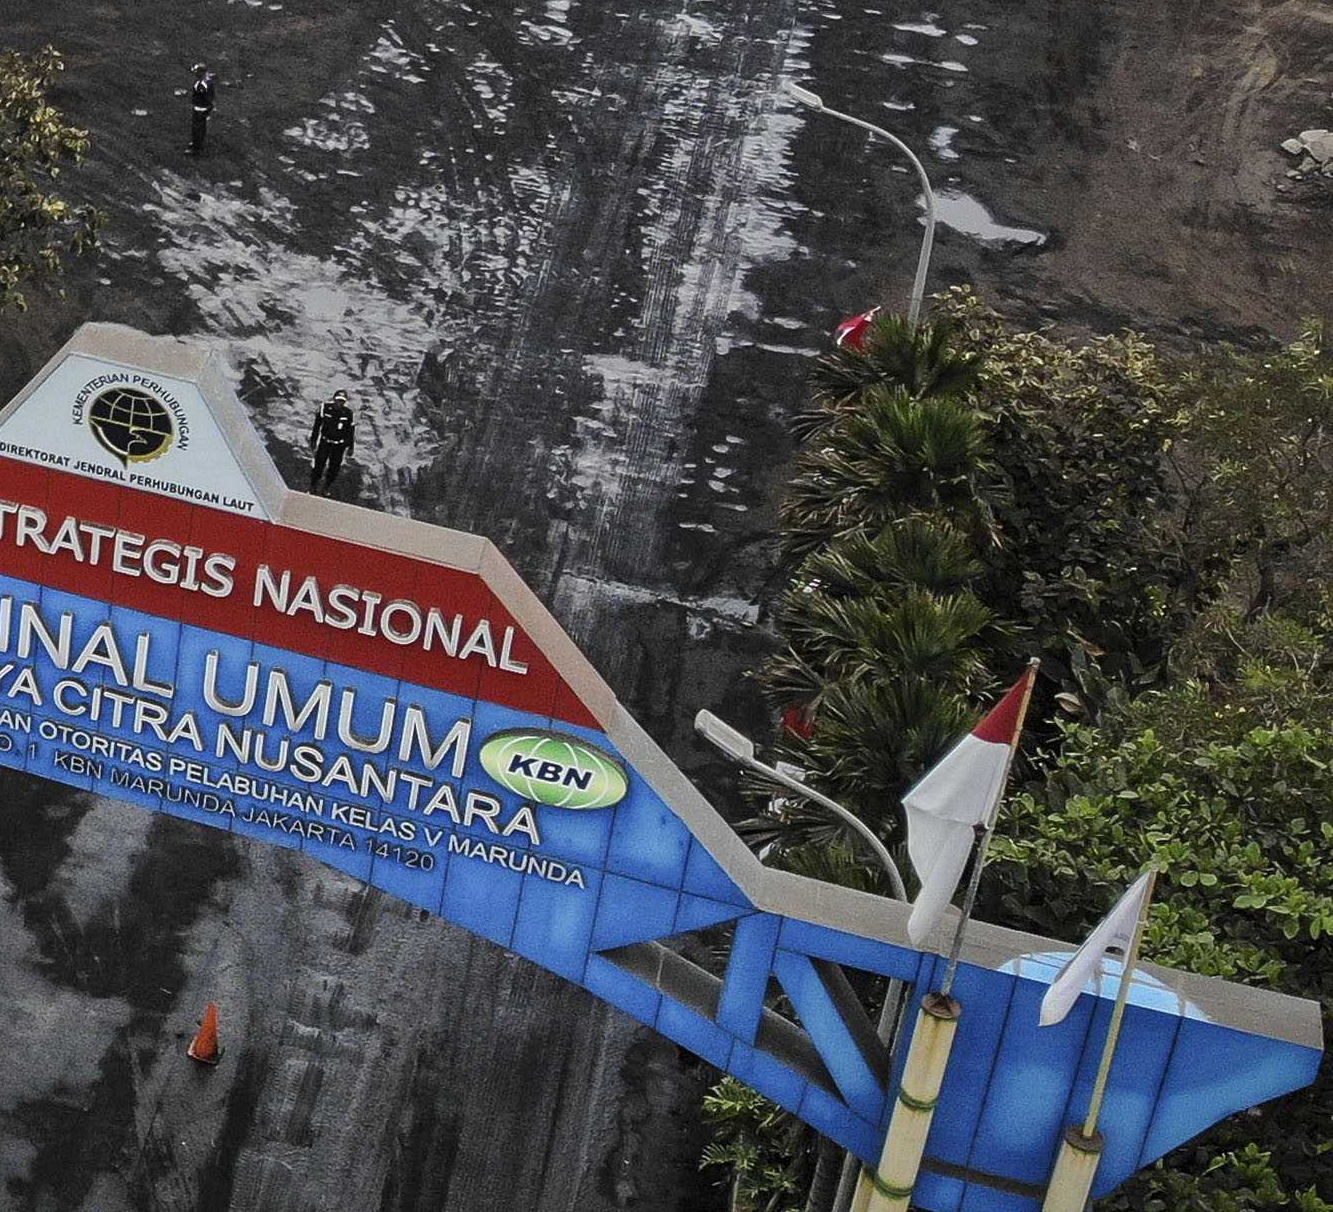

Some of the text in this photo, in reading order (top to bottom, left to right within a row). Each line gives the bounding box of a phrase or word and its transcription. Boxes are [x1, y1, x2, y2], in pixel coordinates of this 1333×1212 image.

[72, 373, 190, 452] KEMENTERIAN PERHUBUNGAN
[73, 459, 126, 482] JENDRAL
[129, 473, 220, 505] PERHUBUNGAN
[222, 495, 254, 513] LAUT
[253, 563, 529, 675] NASIONAL
[53, 677, 204, 752] CITRA
[216, 722, 540, 846] NUSANTARA
[203, 649, 472, 778] UMUM
[506, 753, 595, 793] KBN
[27, 742, 37, 759] 1
[53, 749, 103, 780] KBN
[110, 766, 236, 817] MARUNDA
[242, 805, 356, 852] JAKARTA
[365, 836, 435, 873] 14120
[38, 720, 163, 772] OTORITAS
[169, 758, 324, 817] PELABUHAN
[331, 801, 416, 841] KELAS
[423, 827, 444, 848] V
[448, 833, 586, 890] MARUNDA
